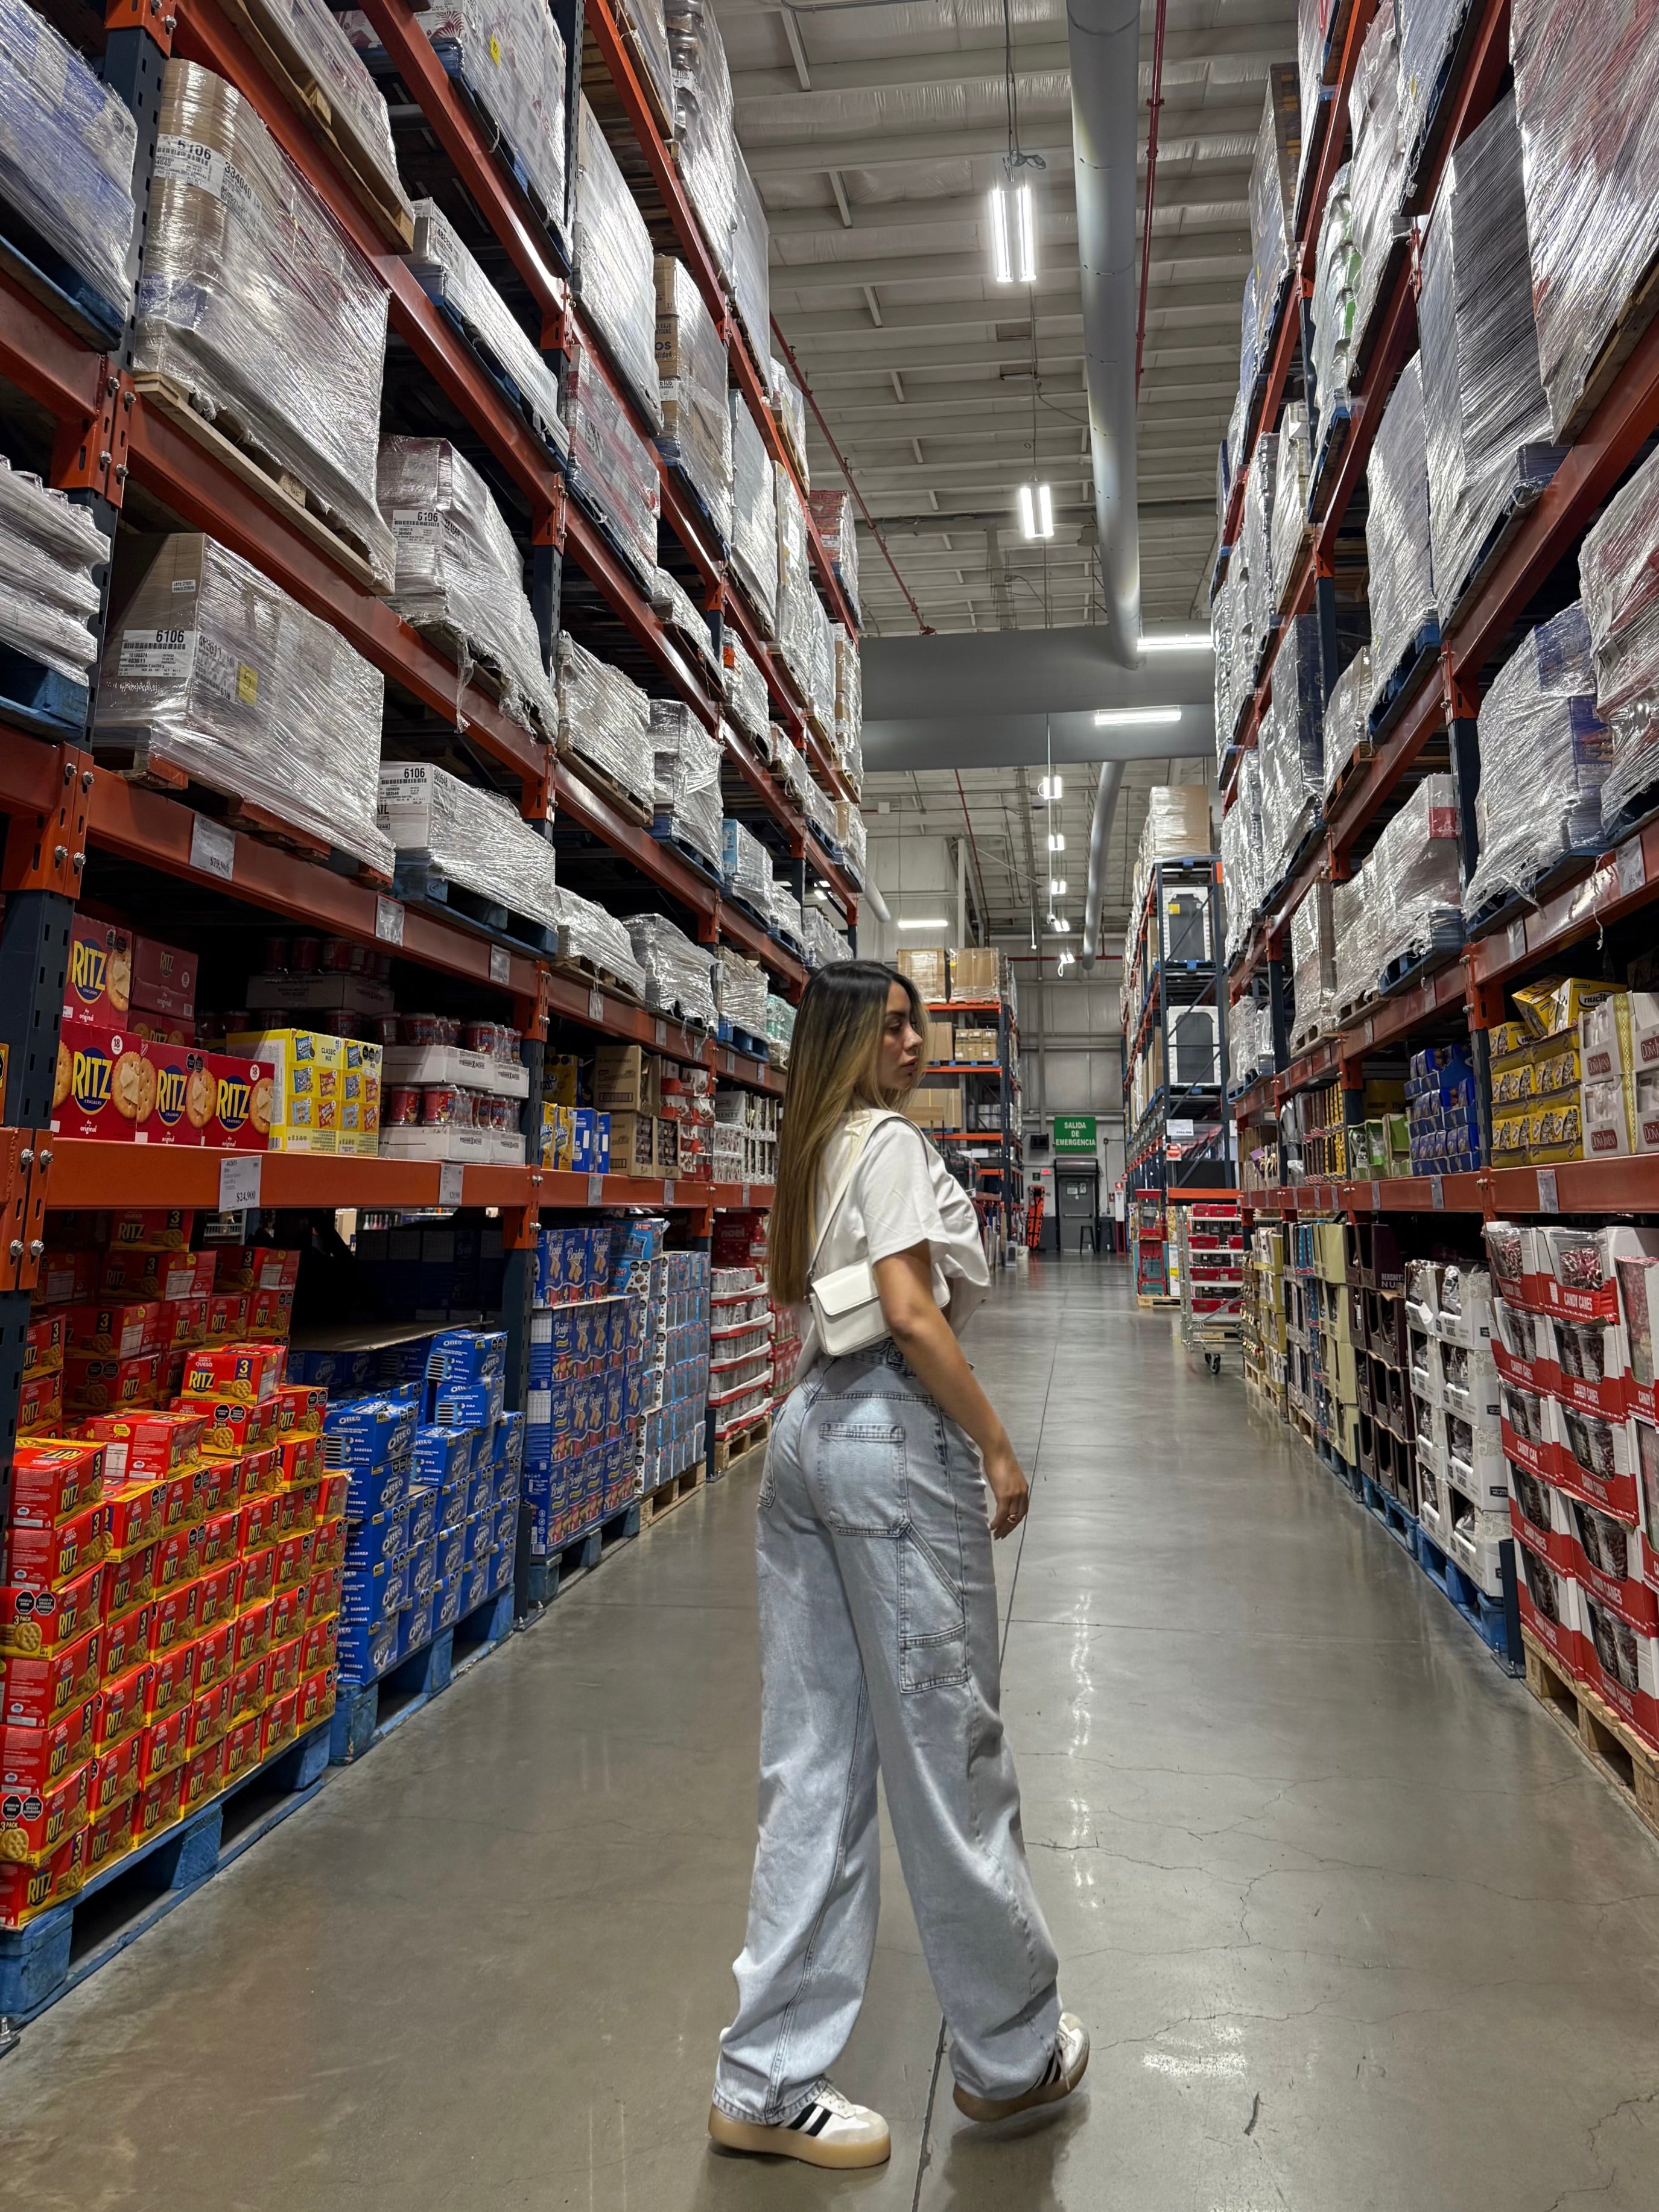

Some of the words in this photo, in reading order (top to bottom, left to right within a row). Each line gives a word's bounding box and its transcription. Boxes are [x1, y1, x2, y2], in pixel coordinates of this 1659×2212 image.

[224, 162, 252, 199] 334040
[417, 512, 438, 522] 6106
[156, 630, 184, 642] 6106
[404, 768, 425, 778] 6106
[72, 940, 107, 990] RITZ
[160, 951, 174, 972] RITZ
[79, 1013, 94, 1022] original
[114, 1039, 120, 1048] 18
[72, 1051, 113, 1100] RITZ
[156, 1070, 188, 1112] RITZ
[216, 1079, 251, 1119] RITZ
[80, 1125, 97, 1134] original
[236, 1191, 256, 1202] $24,900
[118, 1222, 145, 1239] RITZ
[722, 1228, 745, 1237] noel
[1564, 1292, 1578, 1308] CANDY
[1579, 1296, 1593, 1311] CANES
[212, 1314, 227, 1330] RITZ
[256, 1308, 269, 1325] RITZ
[176, 1320, 189, 1338] RITZ
[240, 1360, 249, 1374] 3
[481, 1357, 499, 1374] OREO
[122, 1378, 139, 1398] RITZ
[189, 1371, 215, 1388] RITZ
[22, 1401, 40, 1424] RITZ
[280, 1412, 296, 1430] RITZ
[247, 1423, 261, 1442] RITZ
[387, 1428, 411, 1450] OREO
[506, 1433, 520, 1451] OREO
[95, 1454, 101, 1470] 3
[245, 1472, 259, 1491] RITZ
[381, 1479, 404, 1503] OREO
[62, 1483, 79, 1511] RITZ
[206, 1488, 220, 1508] RITZ
[446, 1497, 464, 1518] OREO
[94, 1514, 100, 1530] 3
[168, 1500, 183, 1523] RITZ
[128, 1517, 142, 1540] RITZ
[413, 1513, 432, 1536] OREO
[382, 1529, 402, 1553] OREO
[474, 1527, 490, 1548] OREO
[60, 1544, 78, 1573] RITZ
[205, 1539, 220, 1562] RITZ
[163, 1556, 179, 1581] RITZ
[414, 1562, 432, 1586] OREO
[93, 1575, 98, 1592] 3
[113, 1579, 130, 1606] RITZ
[382, 1580, 402, 1608] OREO
[1603, 1582, 1622, 1605] CANES
[203, 1598, 217, 1622] RITZ
[441, 1595, 457, 1619] OREO
[14, 1615, 19, 1624] 3
[59, 1608, 77, 1637] RITZ
[141, 1612, 146, 1628] 3
[409, 1614, 427, 1641] OREO
[160, 1619, 176, 1644] RITZ
[91, 1639, 97, 1655] 3
[108, 1644, 124, 1672] RITZ
[201, 1658, 215, 1683] RITZ
[56, 1675, 74, 1705] RITZ
[138, 1676, 144, 1692] 3
[157, 1681, 173, 1707] RITZ
[107, 1709, 124, 1737] RITZ
[50, 1743, 68, 1772] RITZ
[152, 1743, 168, 1769] RITZ
[102, 1774, 118, 1801] RITZ
[47, 1810, 65, 1840] RITZ
[75, 1834, 81, 1854] 3
[28, 1872, 52, 1903] RITZ
